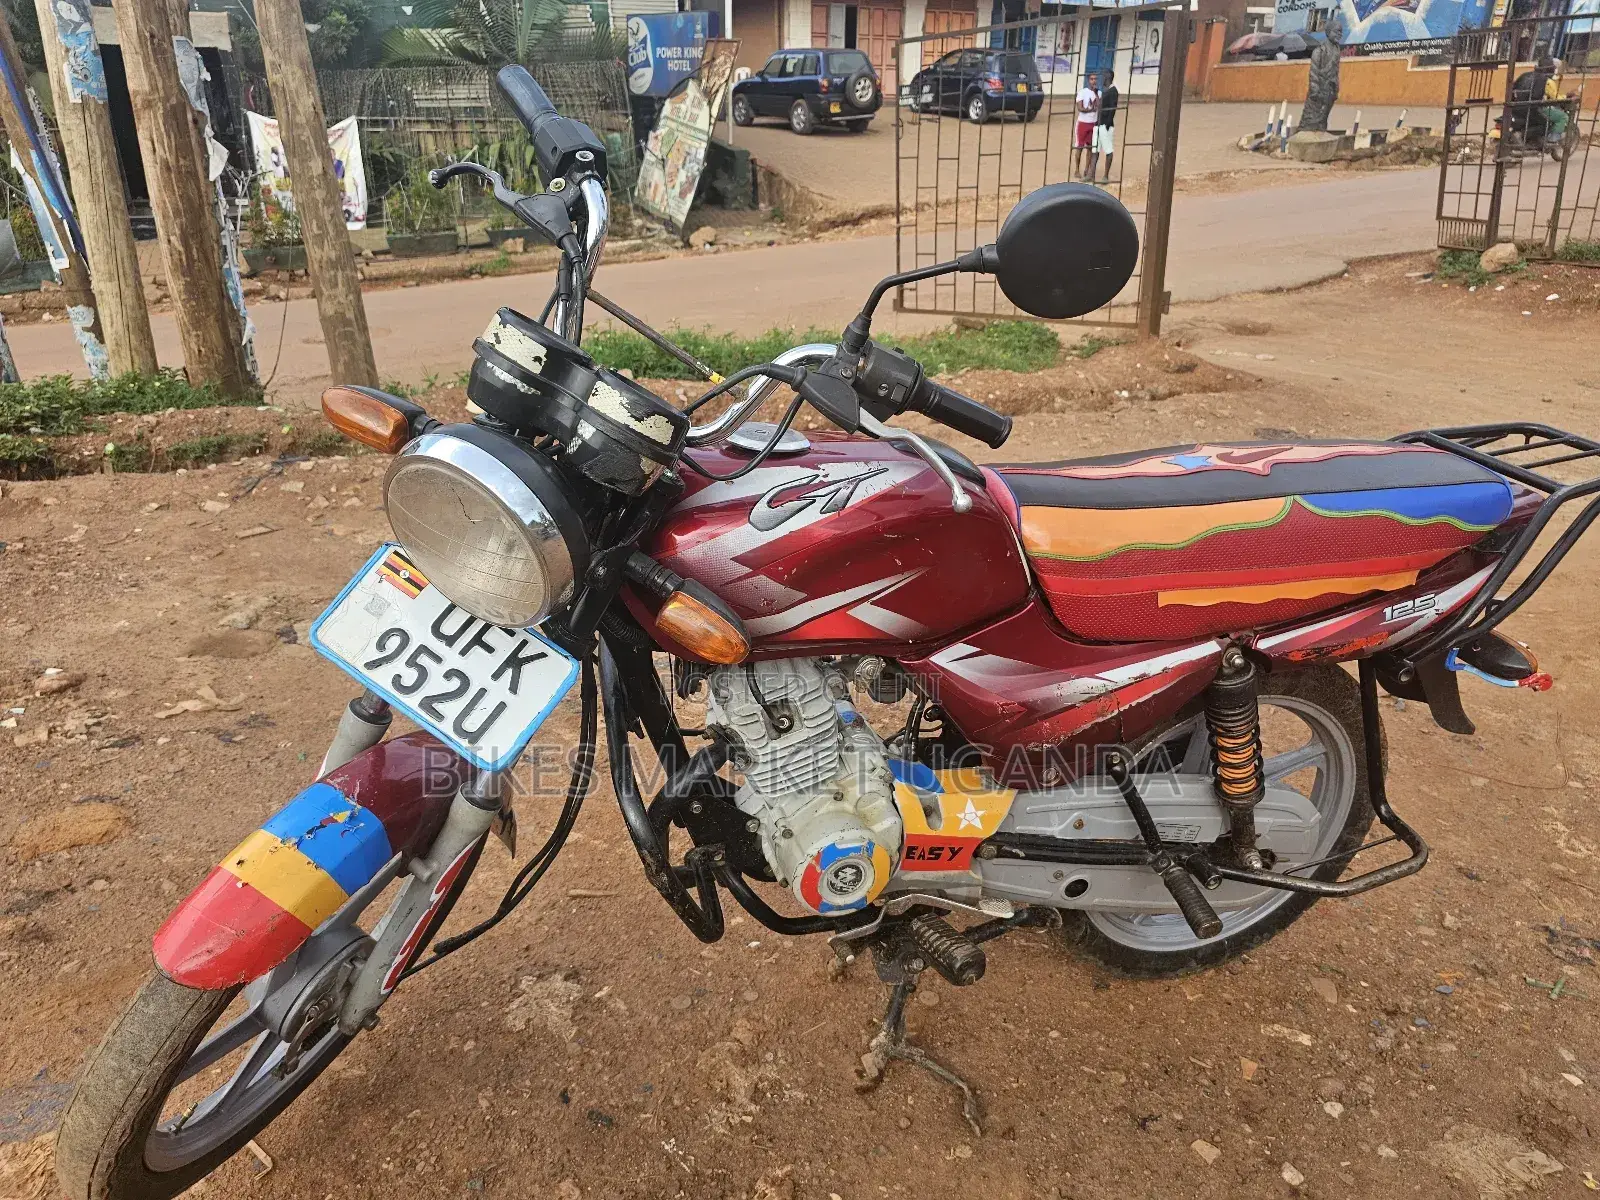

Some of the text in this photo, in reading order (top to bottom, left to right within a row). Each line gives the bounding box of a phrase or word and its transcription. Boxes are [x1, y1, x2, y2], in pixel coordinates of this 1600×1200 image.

[1278, 1, 1316, 13] CONDOMS
[656, 47, 682, 59] POWER
[683, 47, 703, 59] KING
[668, 60, 691, 71] HOTEL
[1383, 593, 1435, 622] 125
[363, 627, 507, 746] 952U
[904, 845, 964, 862] EASY
